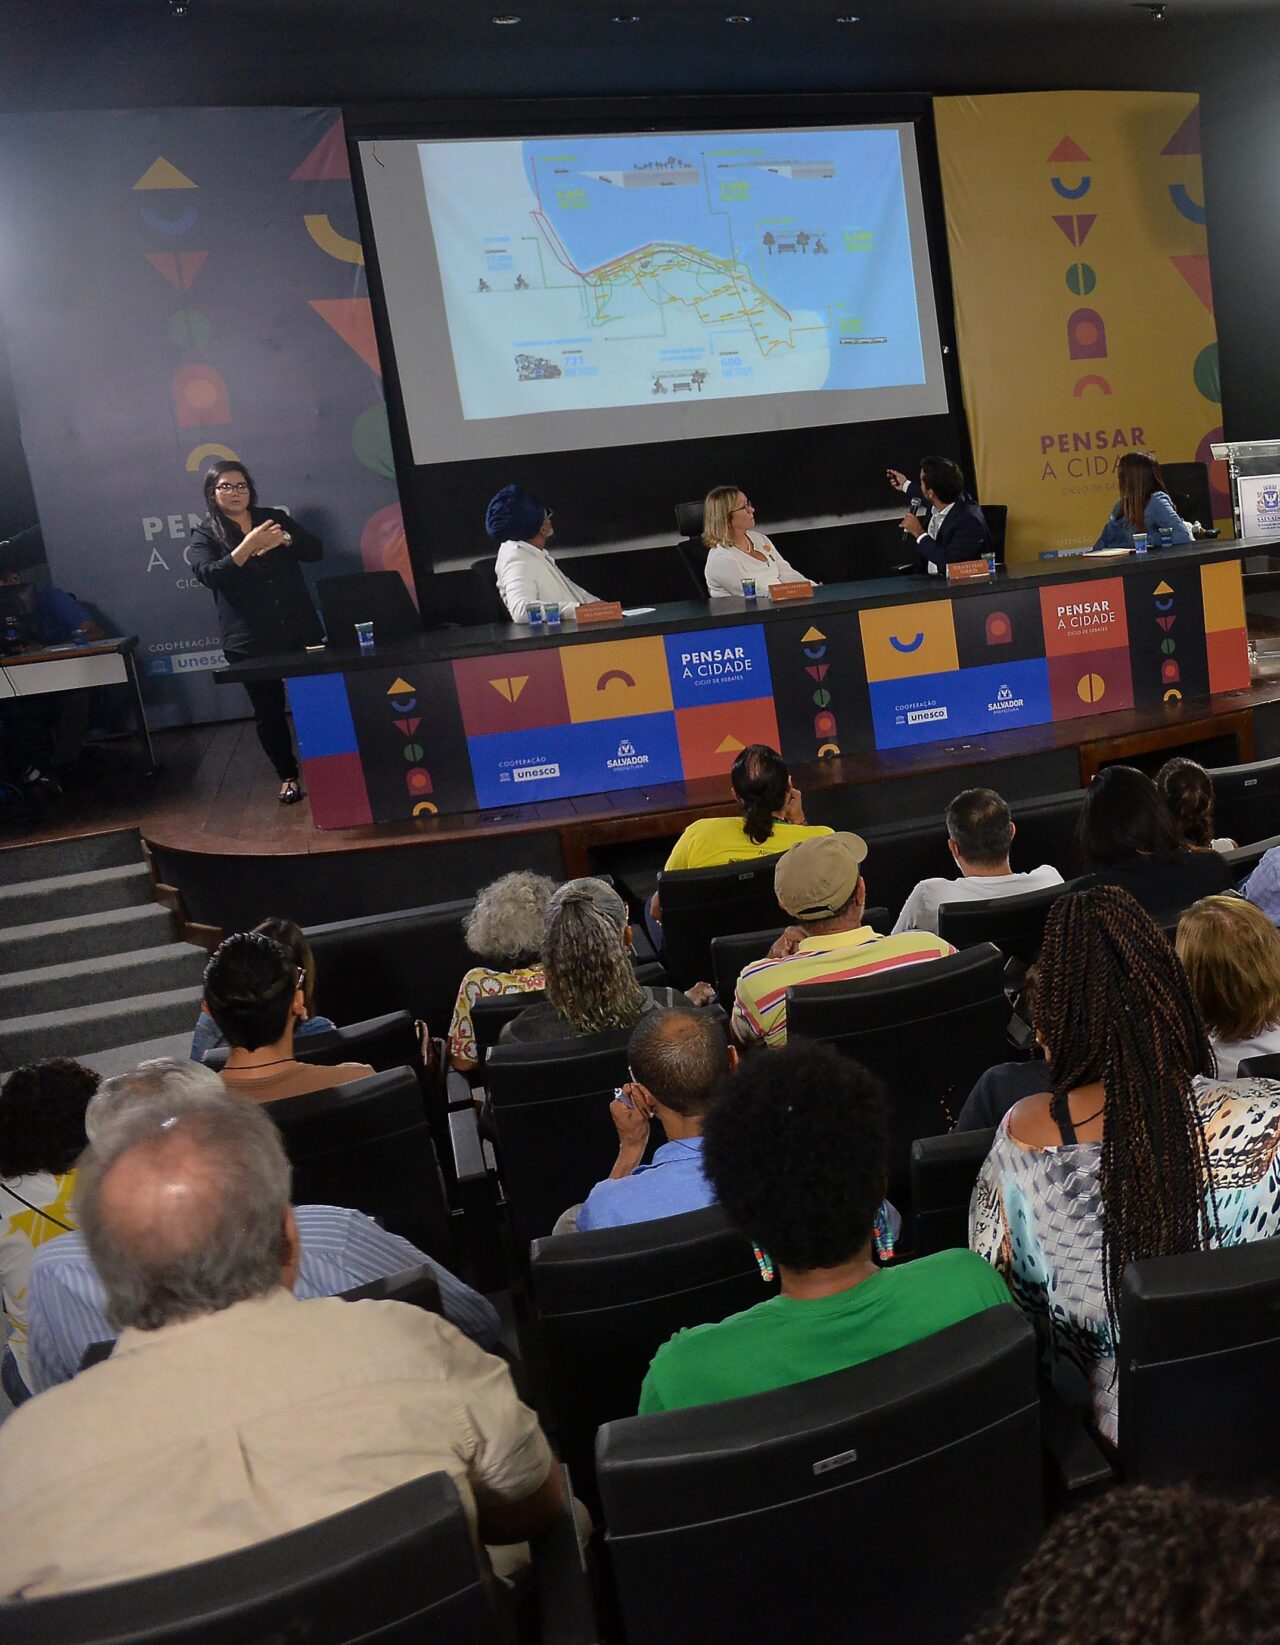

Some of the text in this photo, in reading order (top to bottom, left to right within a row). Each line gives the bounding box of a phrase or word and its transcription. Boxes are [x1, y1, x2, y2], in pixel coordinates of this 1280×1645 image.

[1041, 426, 1147, 455] PENSAR
[1042, 461, 1058, 480] A
[147, 547, 170, 572] A
[1057, 600, 1110, 617] PENSAR
[1057, 612, 1116, 630] A CIDADE
[148, 636, 221, 652] COOPERAÇÃO
[178, 654, 227, 669] unesc
[681, 647, 745, 665] PENSAR
[682, 659, 753, 679] A CIDADE
[721, 675, 744, 683] DEBATES
[895, 700, 937, 711] COOPERAÇÃO
[987, 699, 1024, 711] SALVADOR
[911, 710, 945, 722] unesco
[498, 756, 547, 768] COOPERAÇÃO
[606, 755, 649, 769] SALVADOR
[517, 767, 556, 779] unesco
